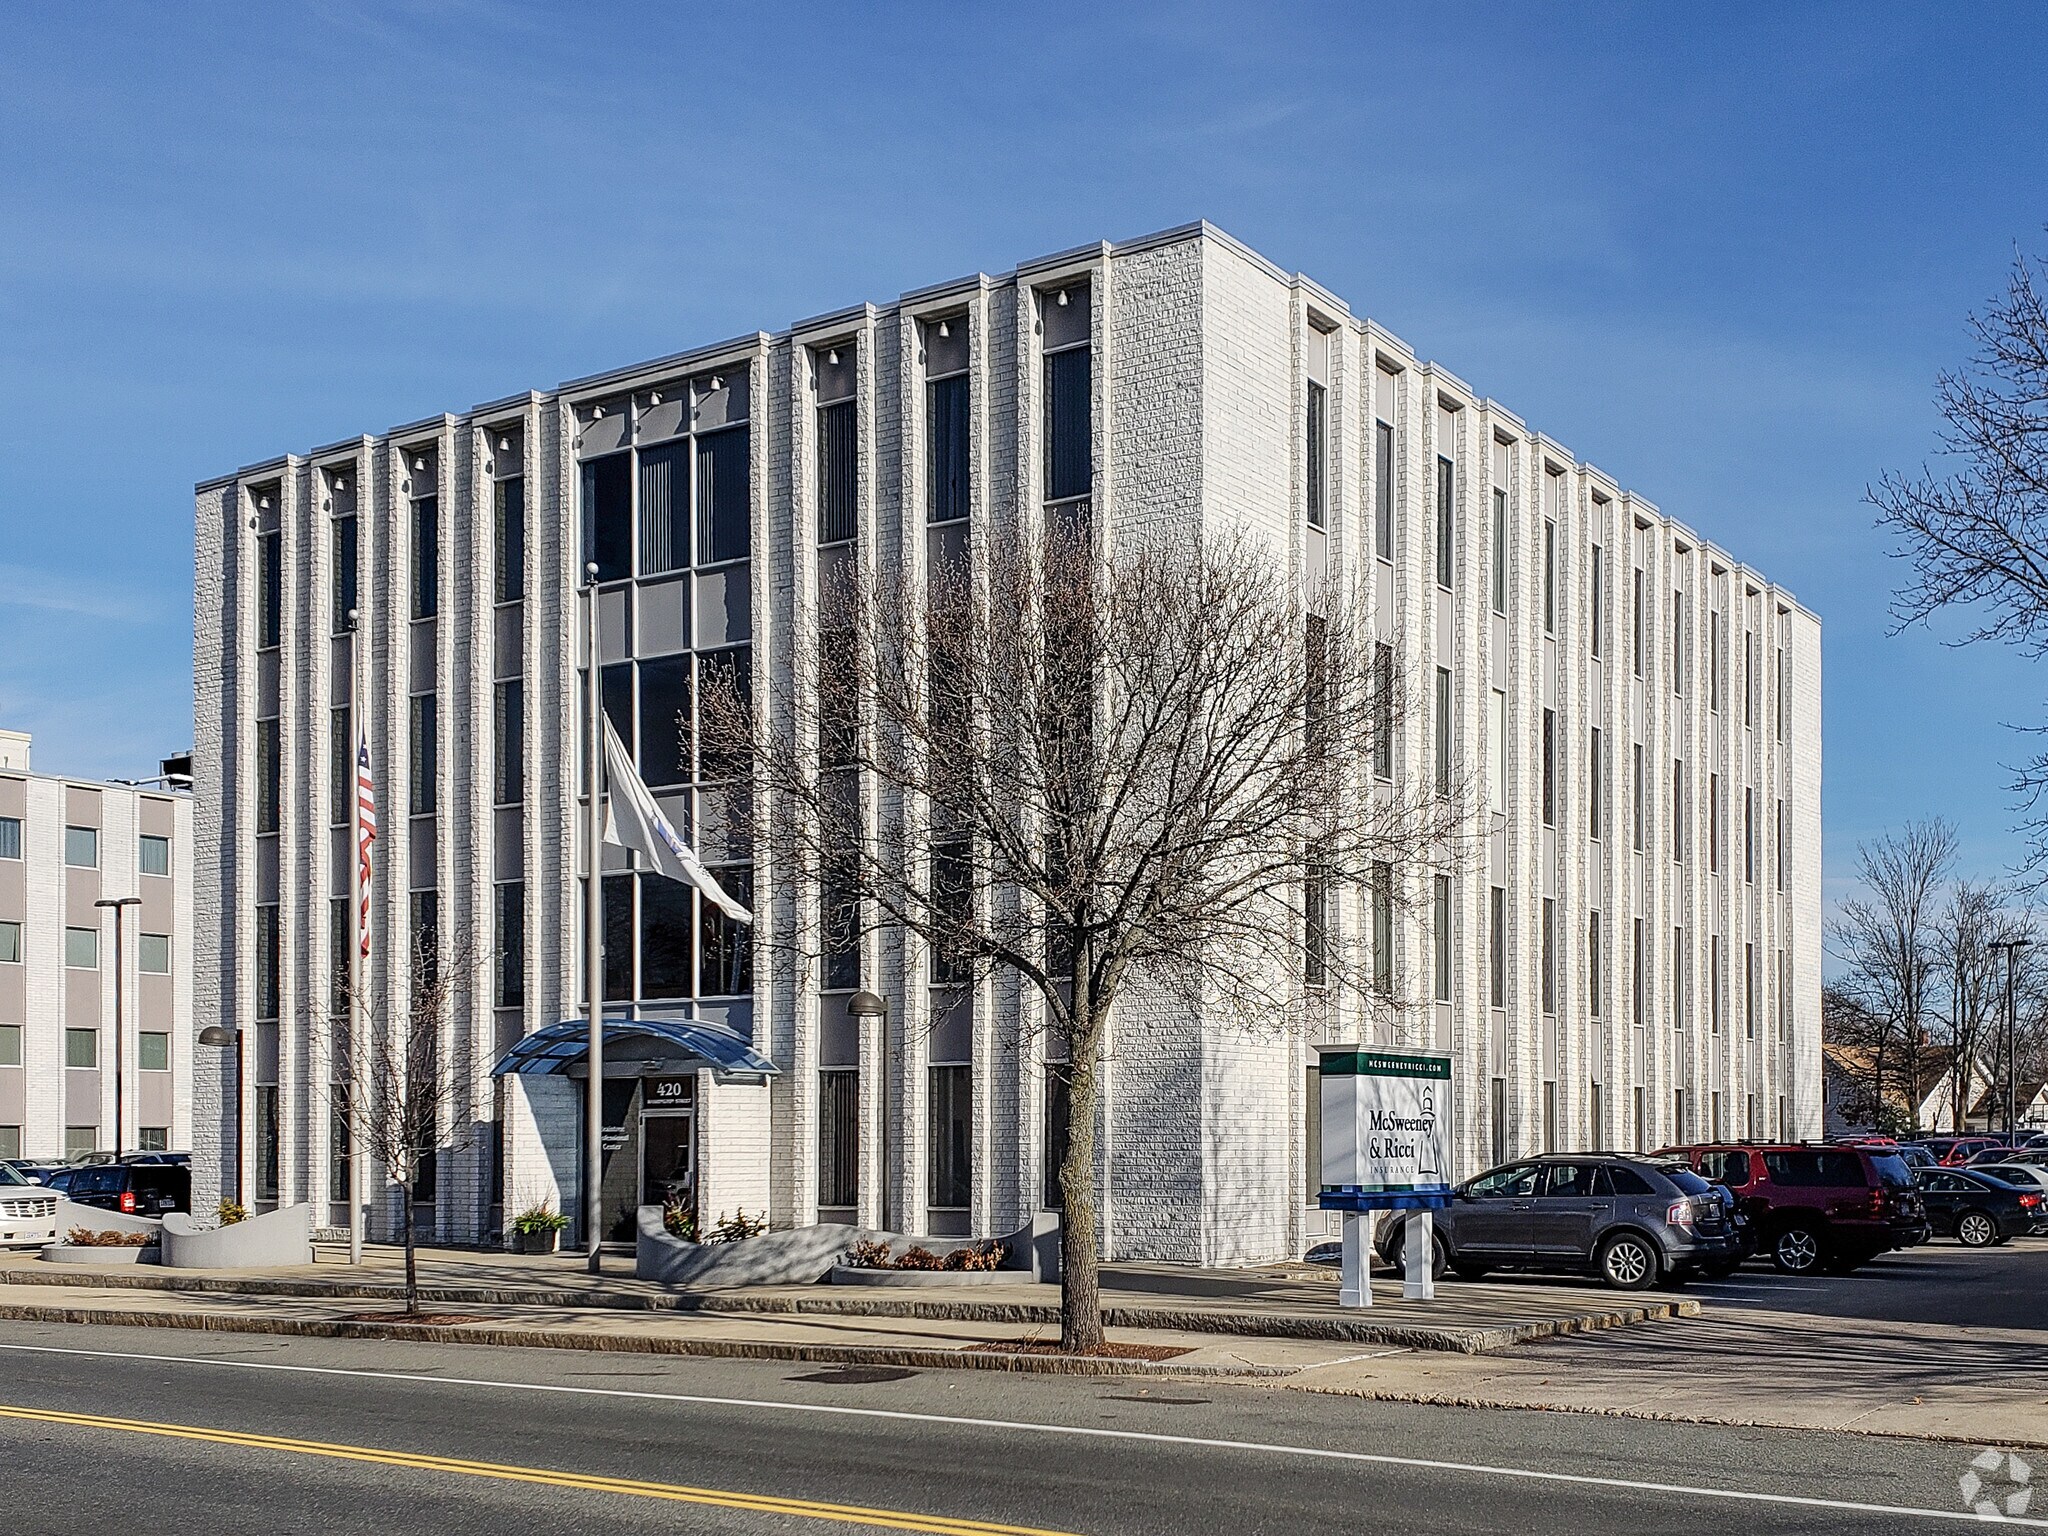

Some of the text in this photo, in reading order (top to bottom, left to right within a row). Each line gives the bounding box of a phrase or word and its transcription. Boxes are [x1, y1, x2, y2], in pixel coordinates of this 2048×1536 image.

[656, 1082, 682, 1096] 420
[1369, 1110, 1435, 1138] McSweeney
[1370, 1137, 1415, 1159] & Ricci
[1370, 1166, 1414, 1174] INSURANCE
